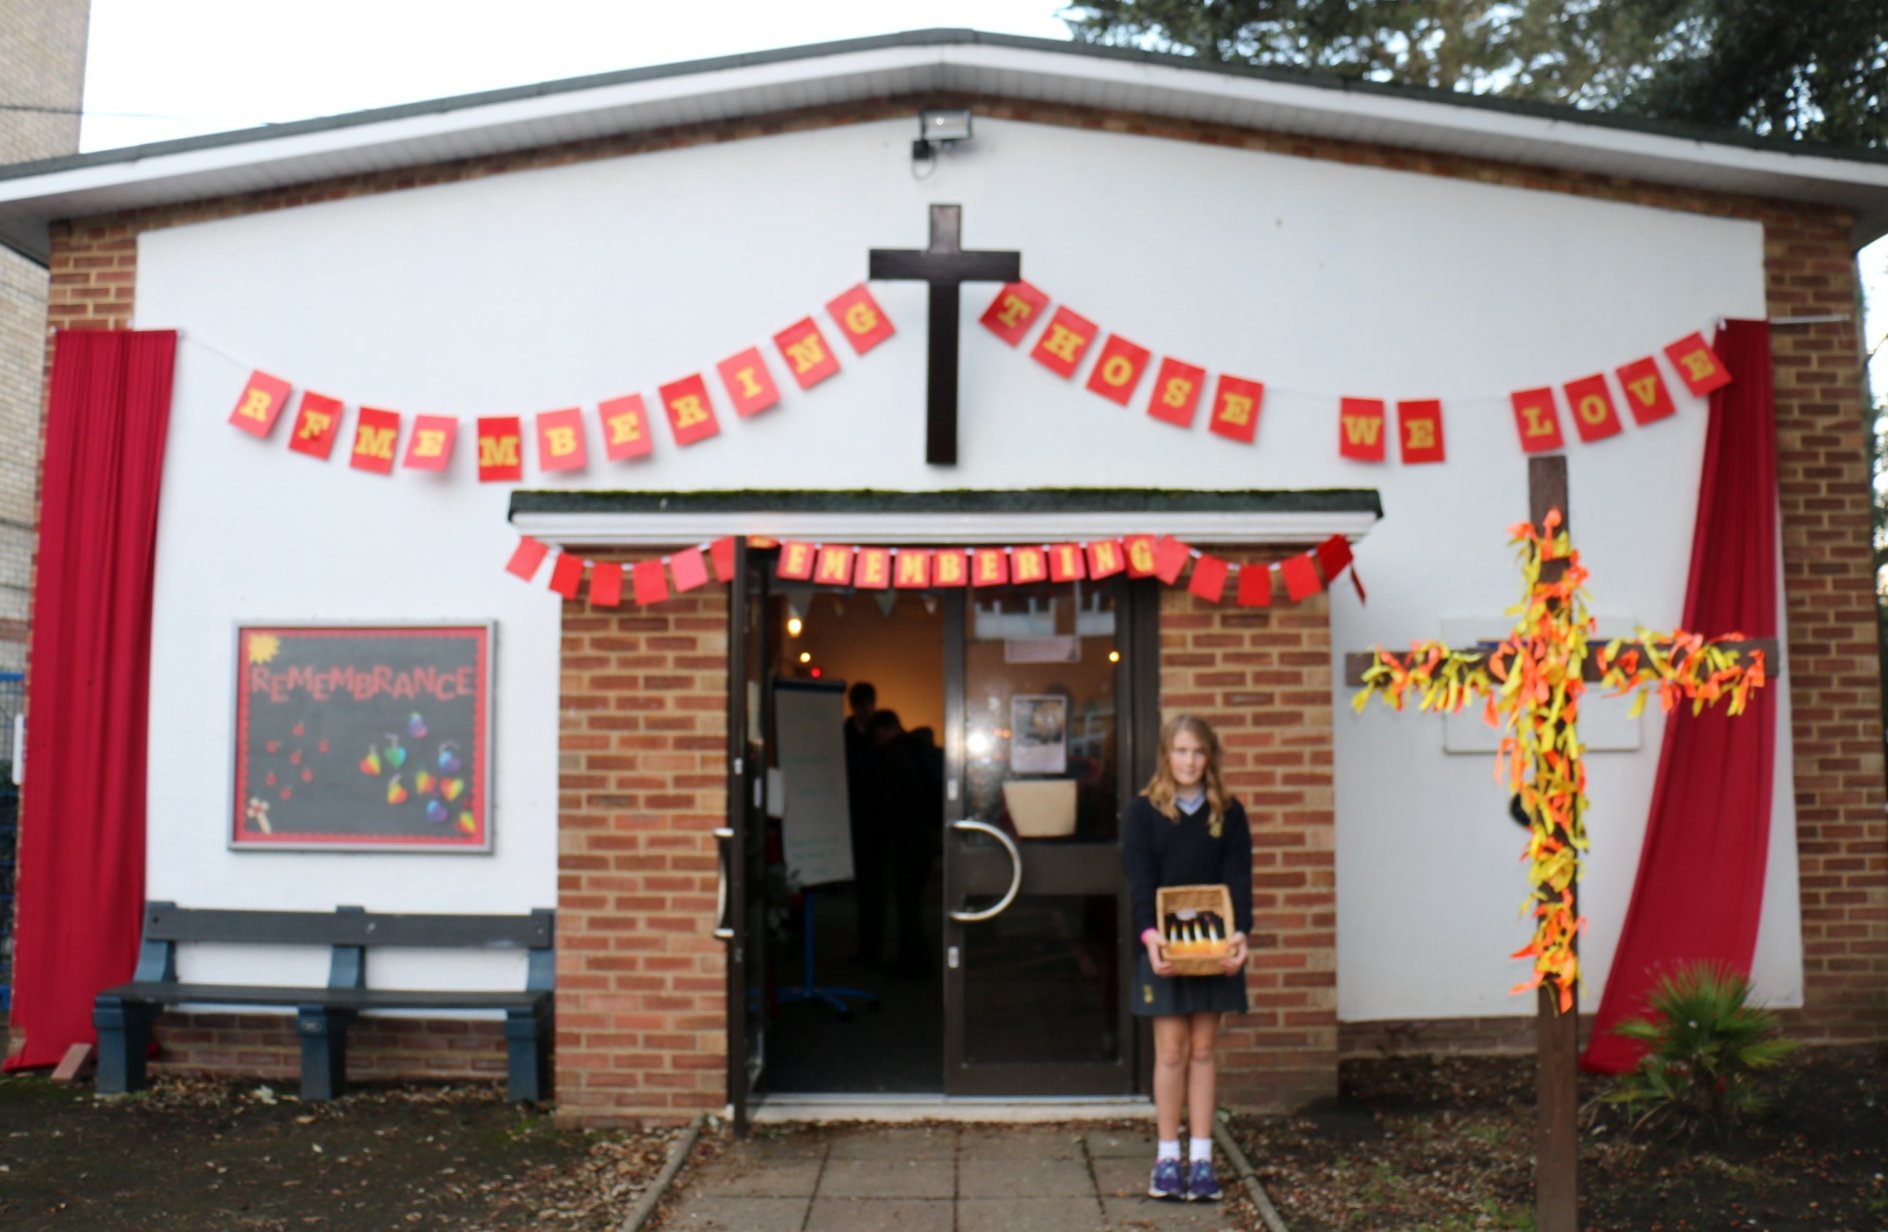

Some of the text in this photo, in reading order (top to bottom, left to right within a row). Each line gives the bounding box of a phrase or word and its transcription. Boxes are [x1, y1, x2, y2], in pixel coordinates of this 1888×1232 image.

[998, 293, 1254, 427] THOSE
[1342, 414, 1436, 450] WE
[1523, 349, 1718, 438] LOVE
[250, 665, 474, 701] REMEMBRANCE
